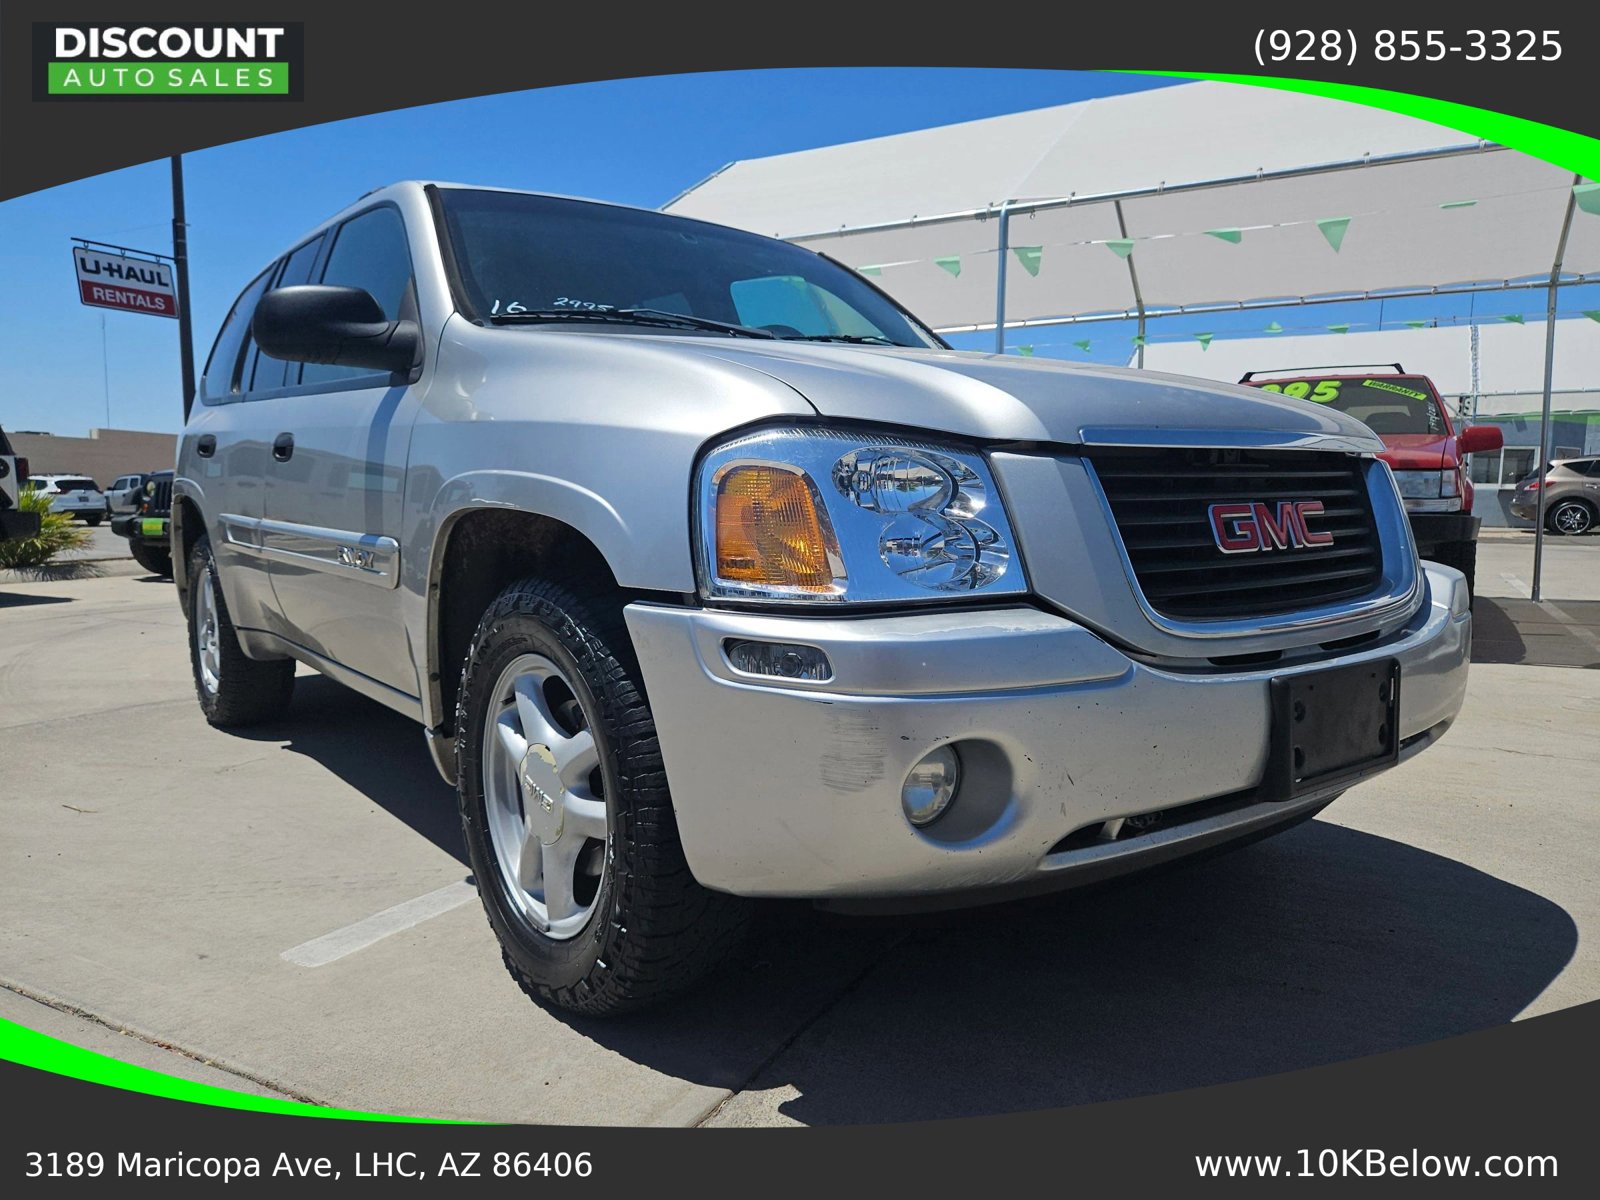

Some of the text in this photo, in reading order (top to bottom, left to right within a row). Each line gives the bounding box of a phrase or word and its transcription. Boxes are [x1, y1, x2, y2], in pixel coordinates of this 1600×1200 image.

[80, 257, 169, 287] U-HAUL
[92, 286, 165, 310] RENTALS
[1369, 380, 1421, 397] WARRANTY
[1208, 501, 1334, 554] GMC
